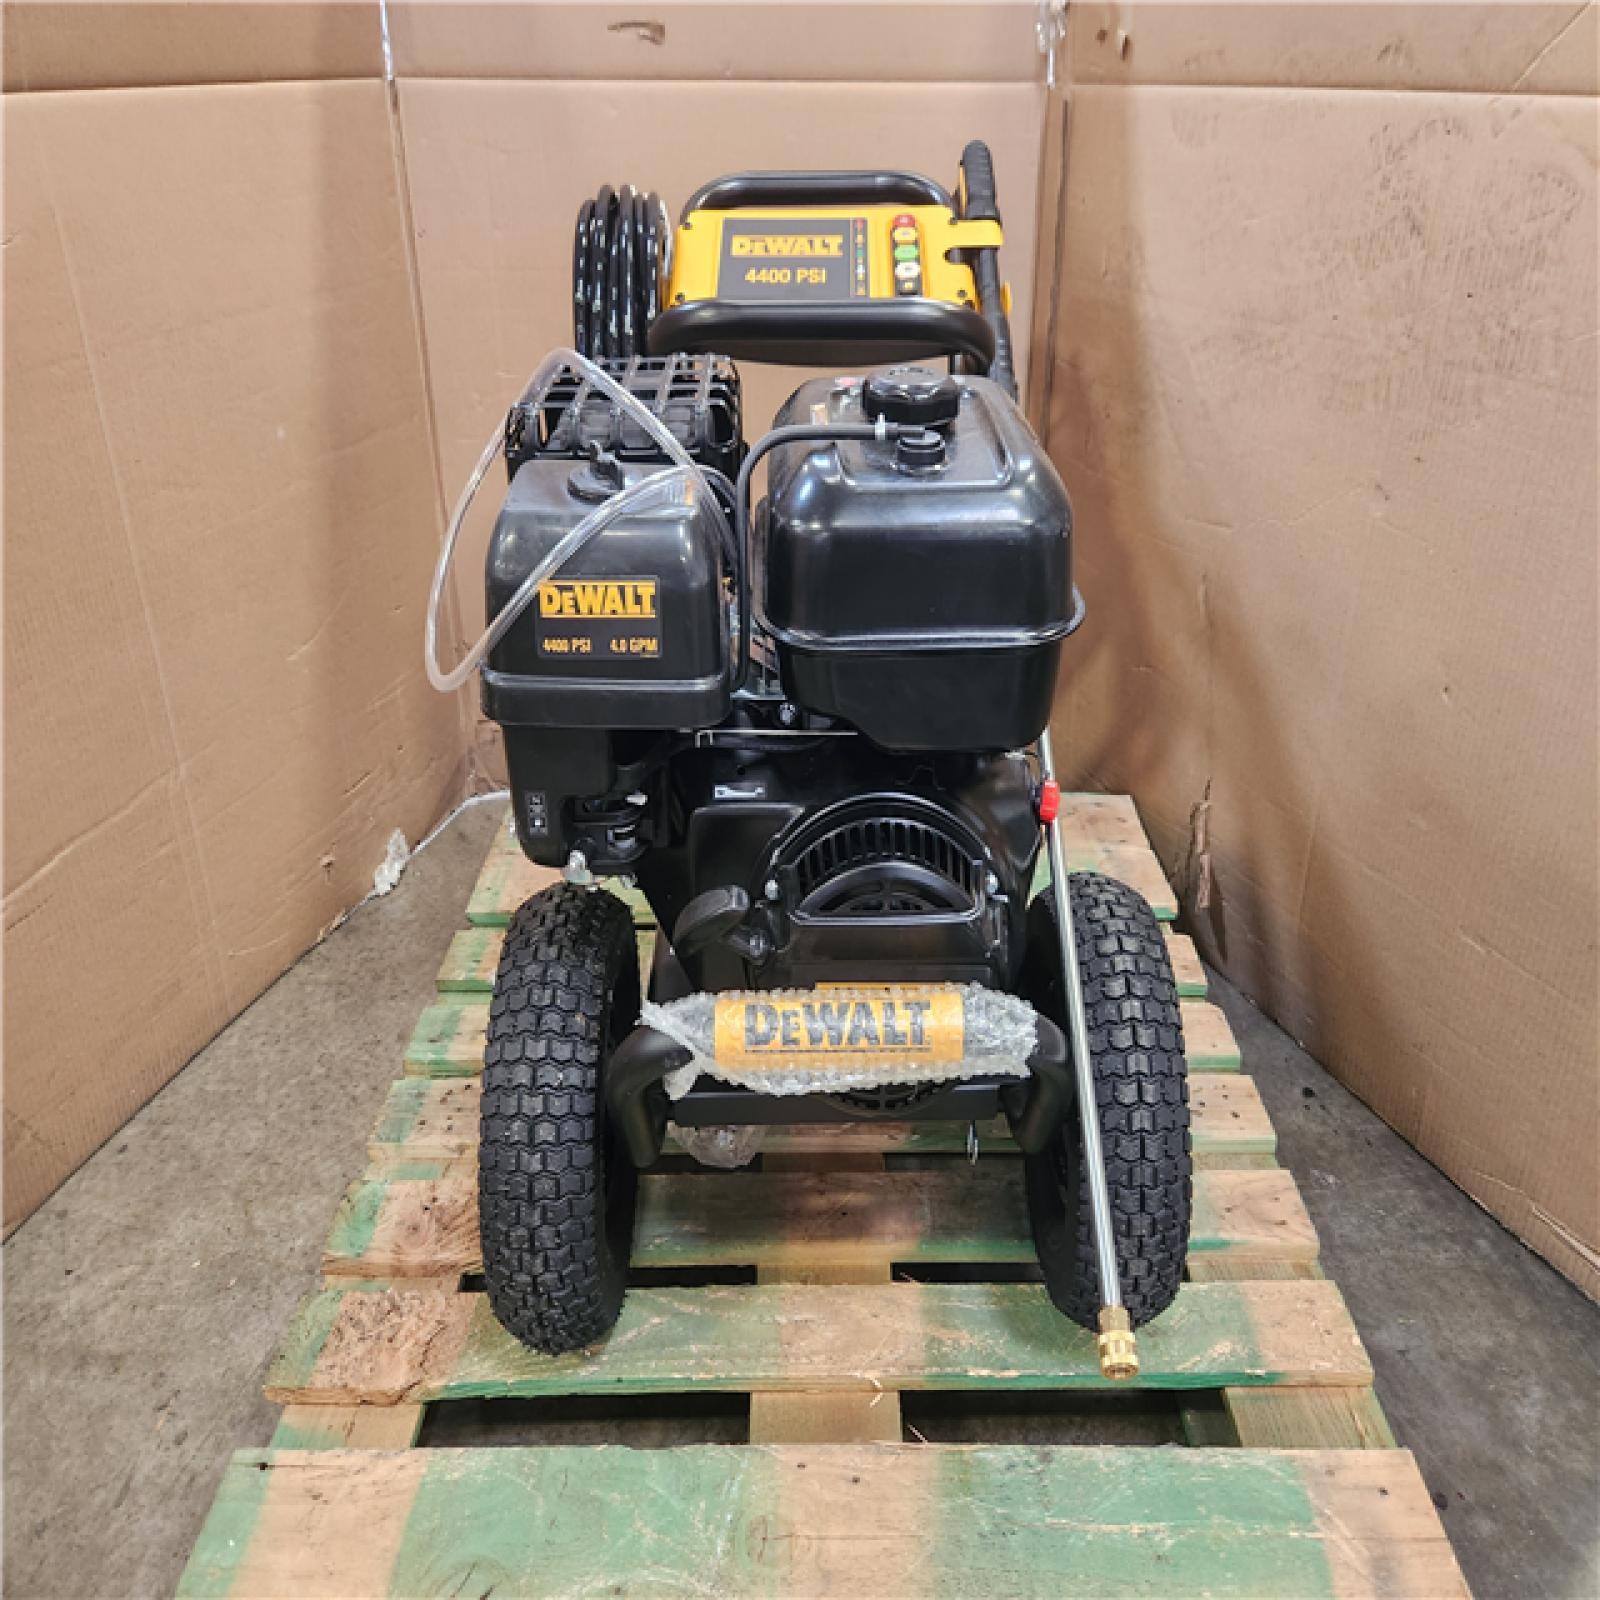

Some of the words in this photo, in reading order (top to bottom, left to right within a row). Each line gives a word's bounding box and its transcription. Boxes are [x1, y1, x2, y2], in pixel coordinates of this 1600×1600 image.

[745, 267, 791, 284] 4400
[796, 267, 827, 284] PSI
[540, 582, 656, 616] DEWALT
[571, 636, 592, 654] PSI
[629, 636, 658, 654] GPM
[744, 1000, 931, 1047] DEWALT
